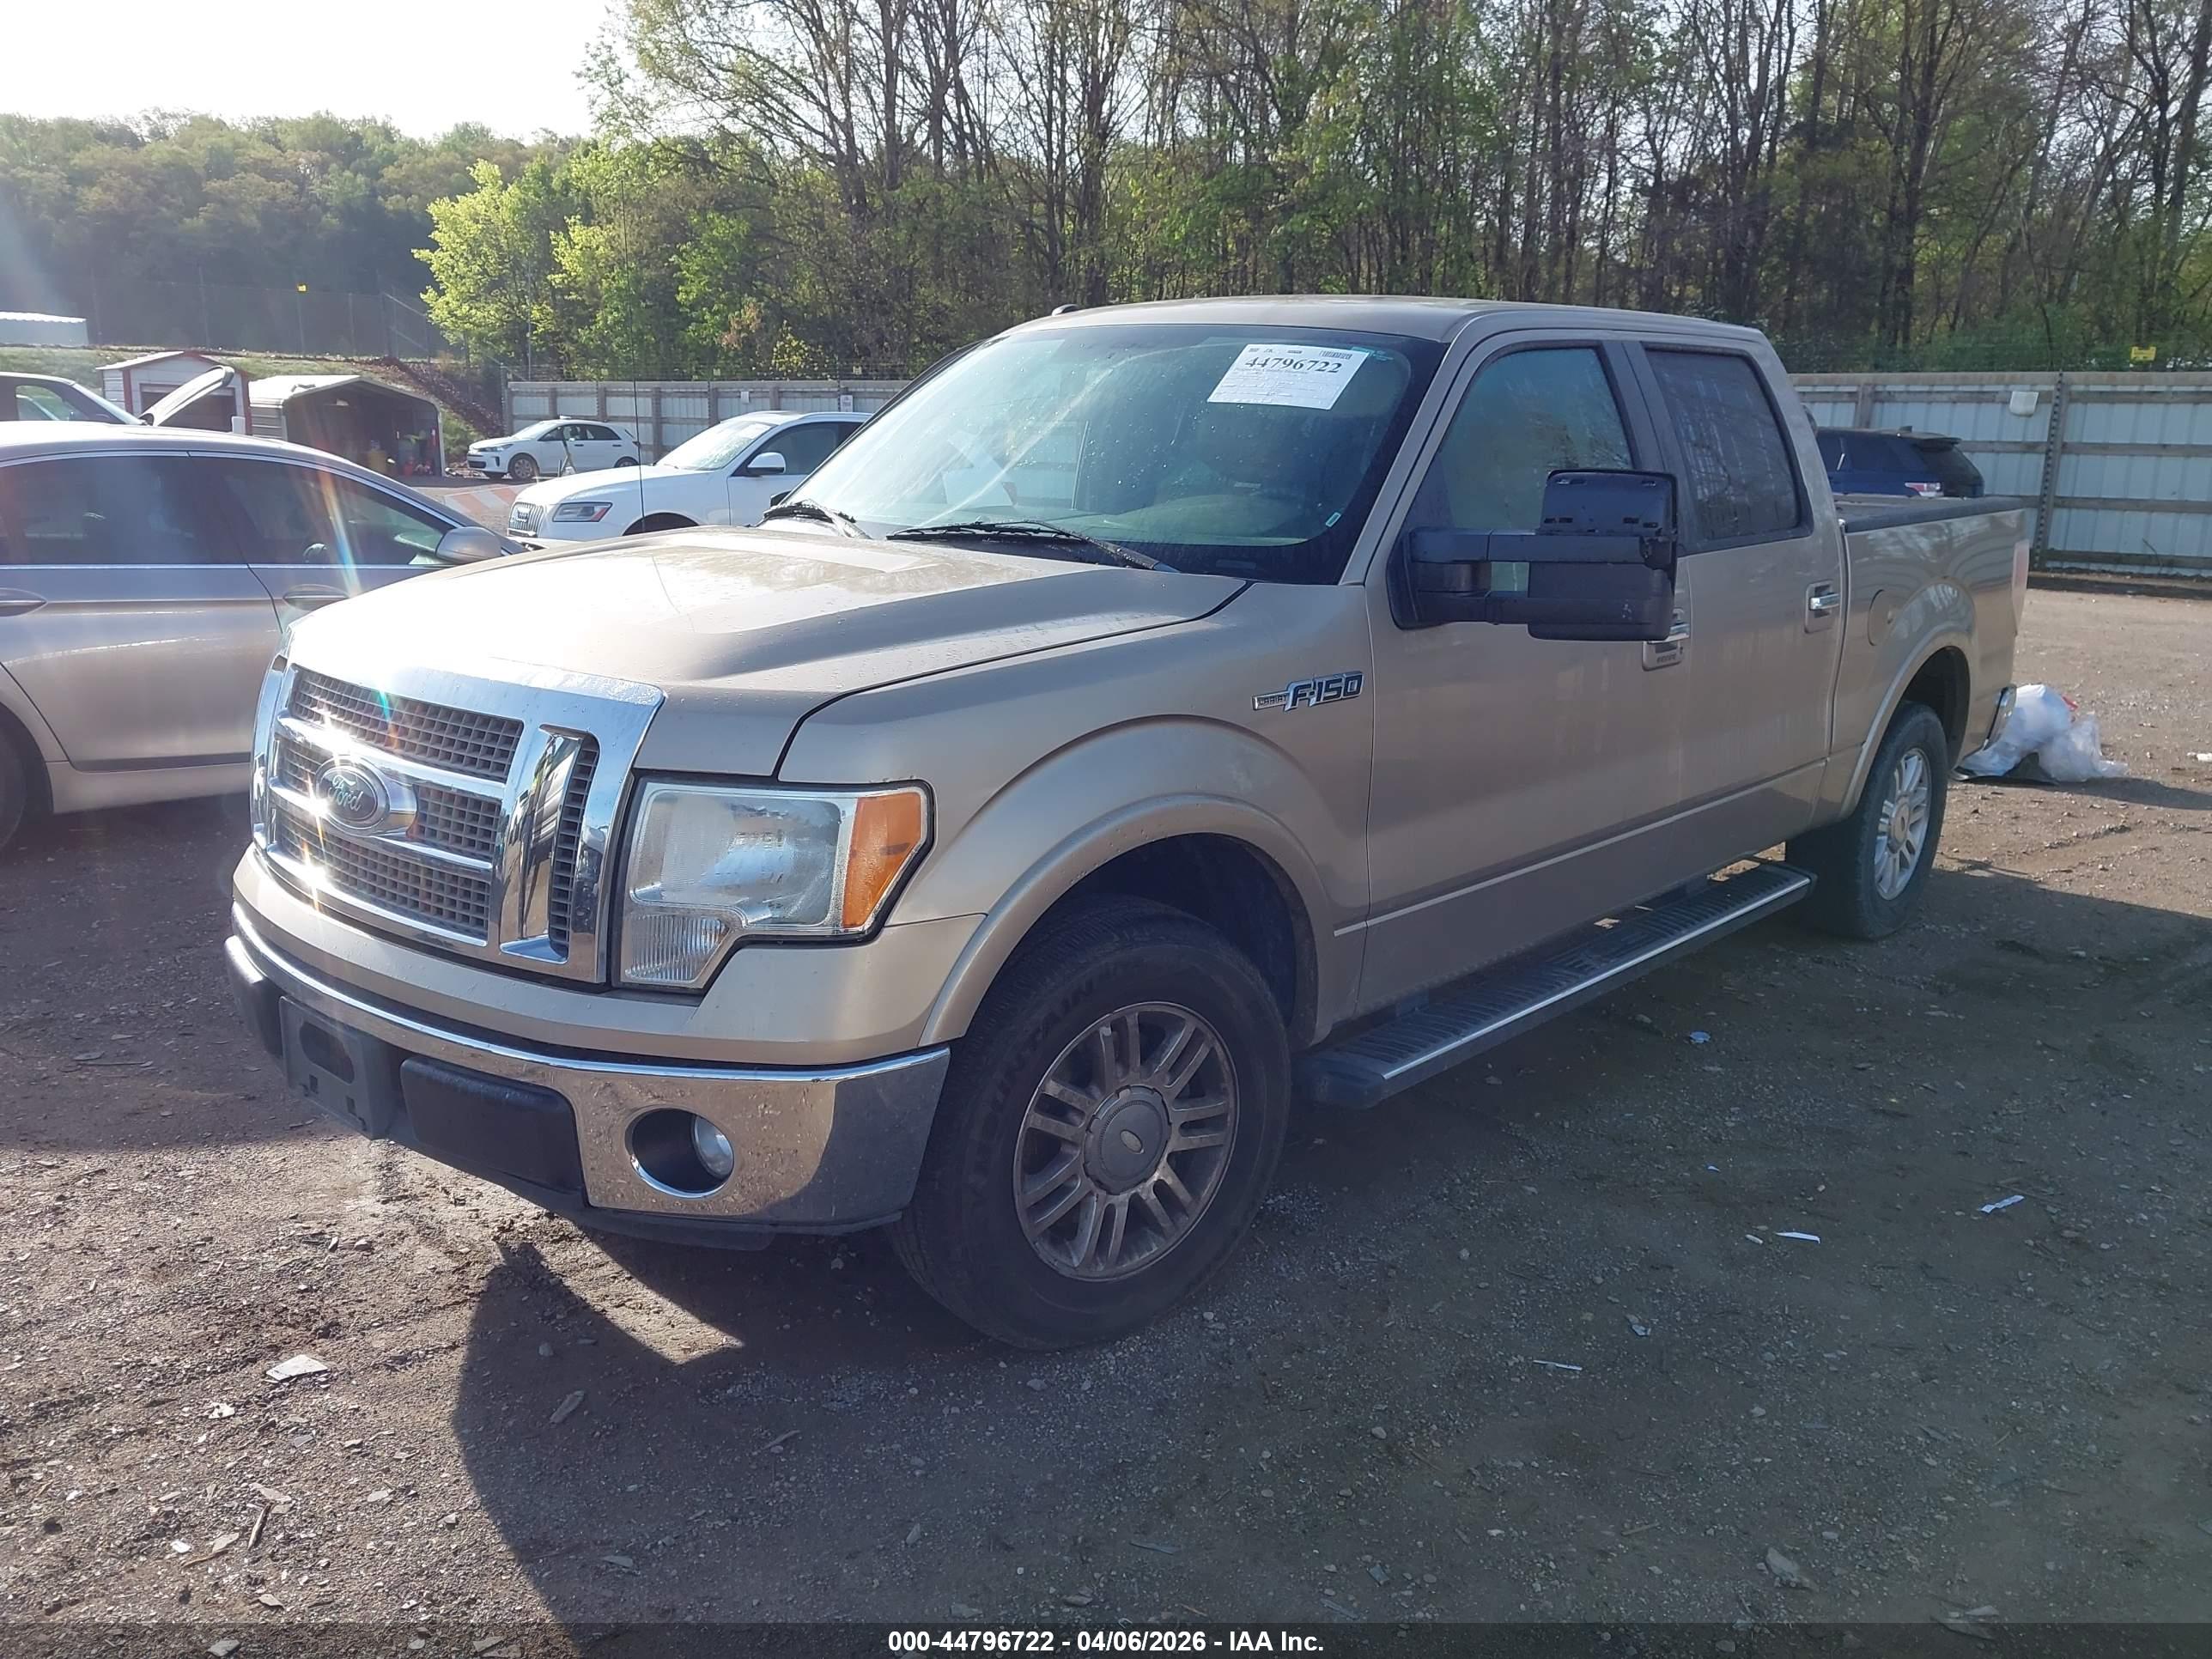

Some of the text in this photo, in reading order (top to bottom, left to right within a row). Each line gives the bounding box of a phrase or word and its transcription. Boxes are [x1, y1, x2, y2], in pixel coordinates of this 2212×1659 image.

[1245, 357, 1342, 374] 44796722
[1285, 673, 1363, 710] F-150
[328, 775, 363, 811] Ford
